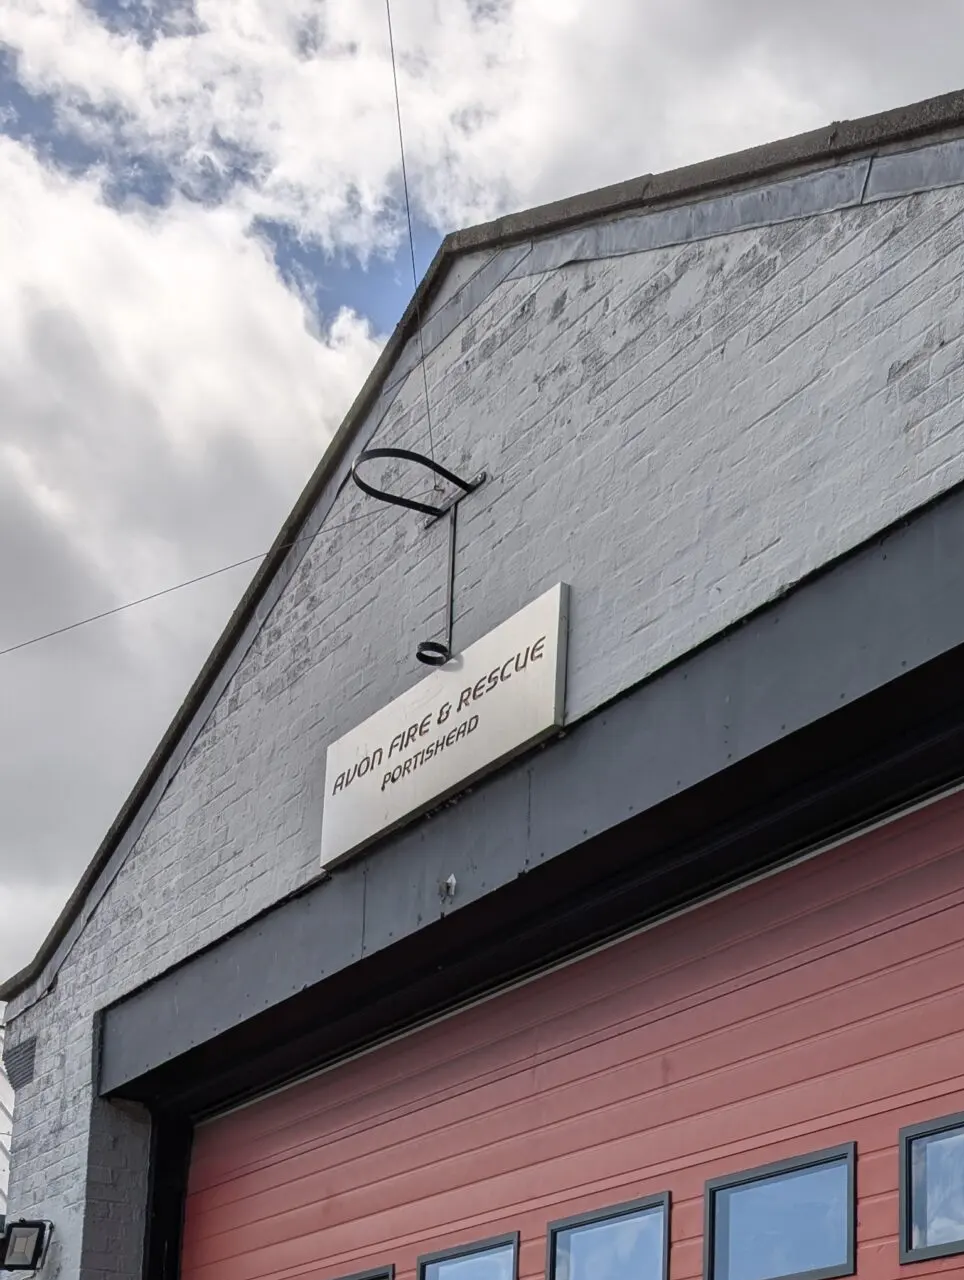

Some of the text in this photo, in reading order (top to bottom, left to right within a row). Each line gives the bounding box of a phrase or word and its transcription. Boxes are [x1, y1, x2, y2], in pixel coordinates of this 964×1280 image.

[332, 635, 546, 797] AVON FIRE & RESCUE
[380, 714, 480, 792] PORTISHEAD
